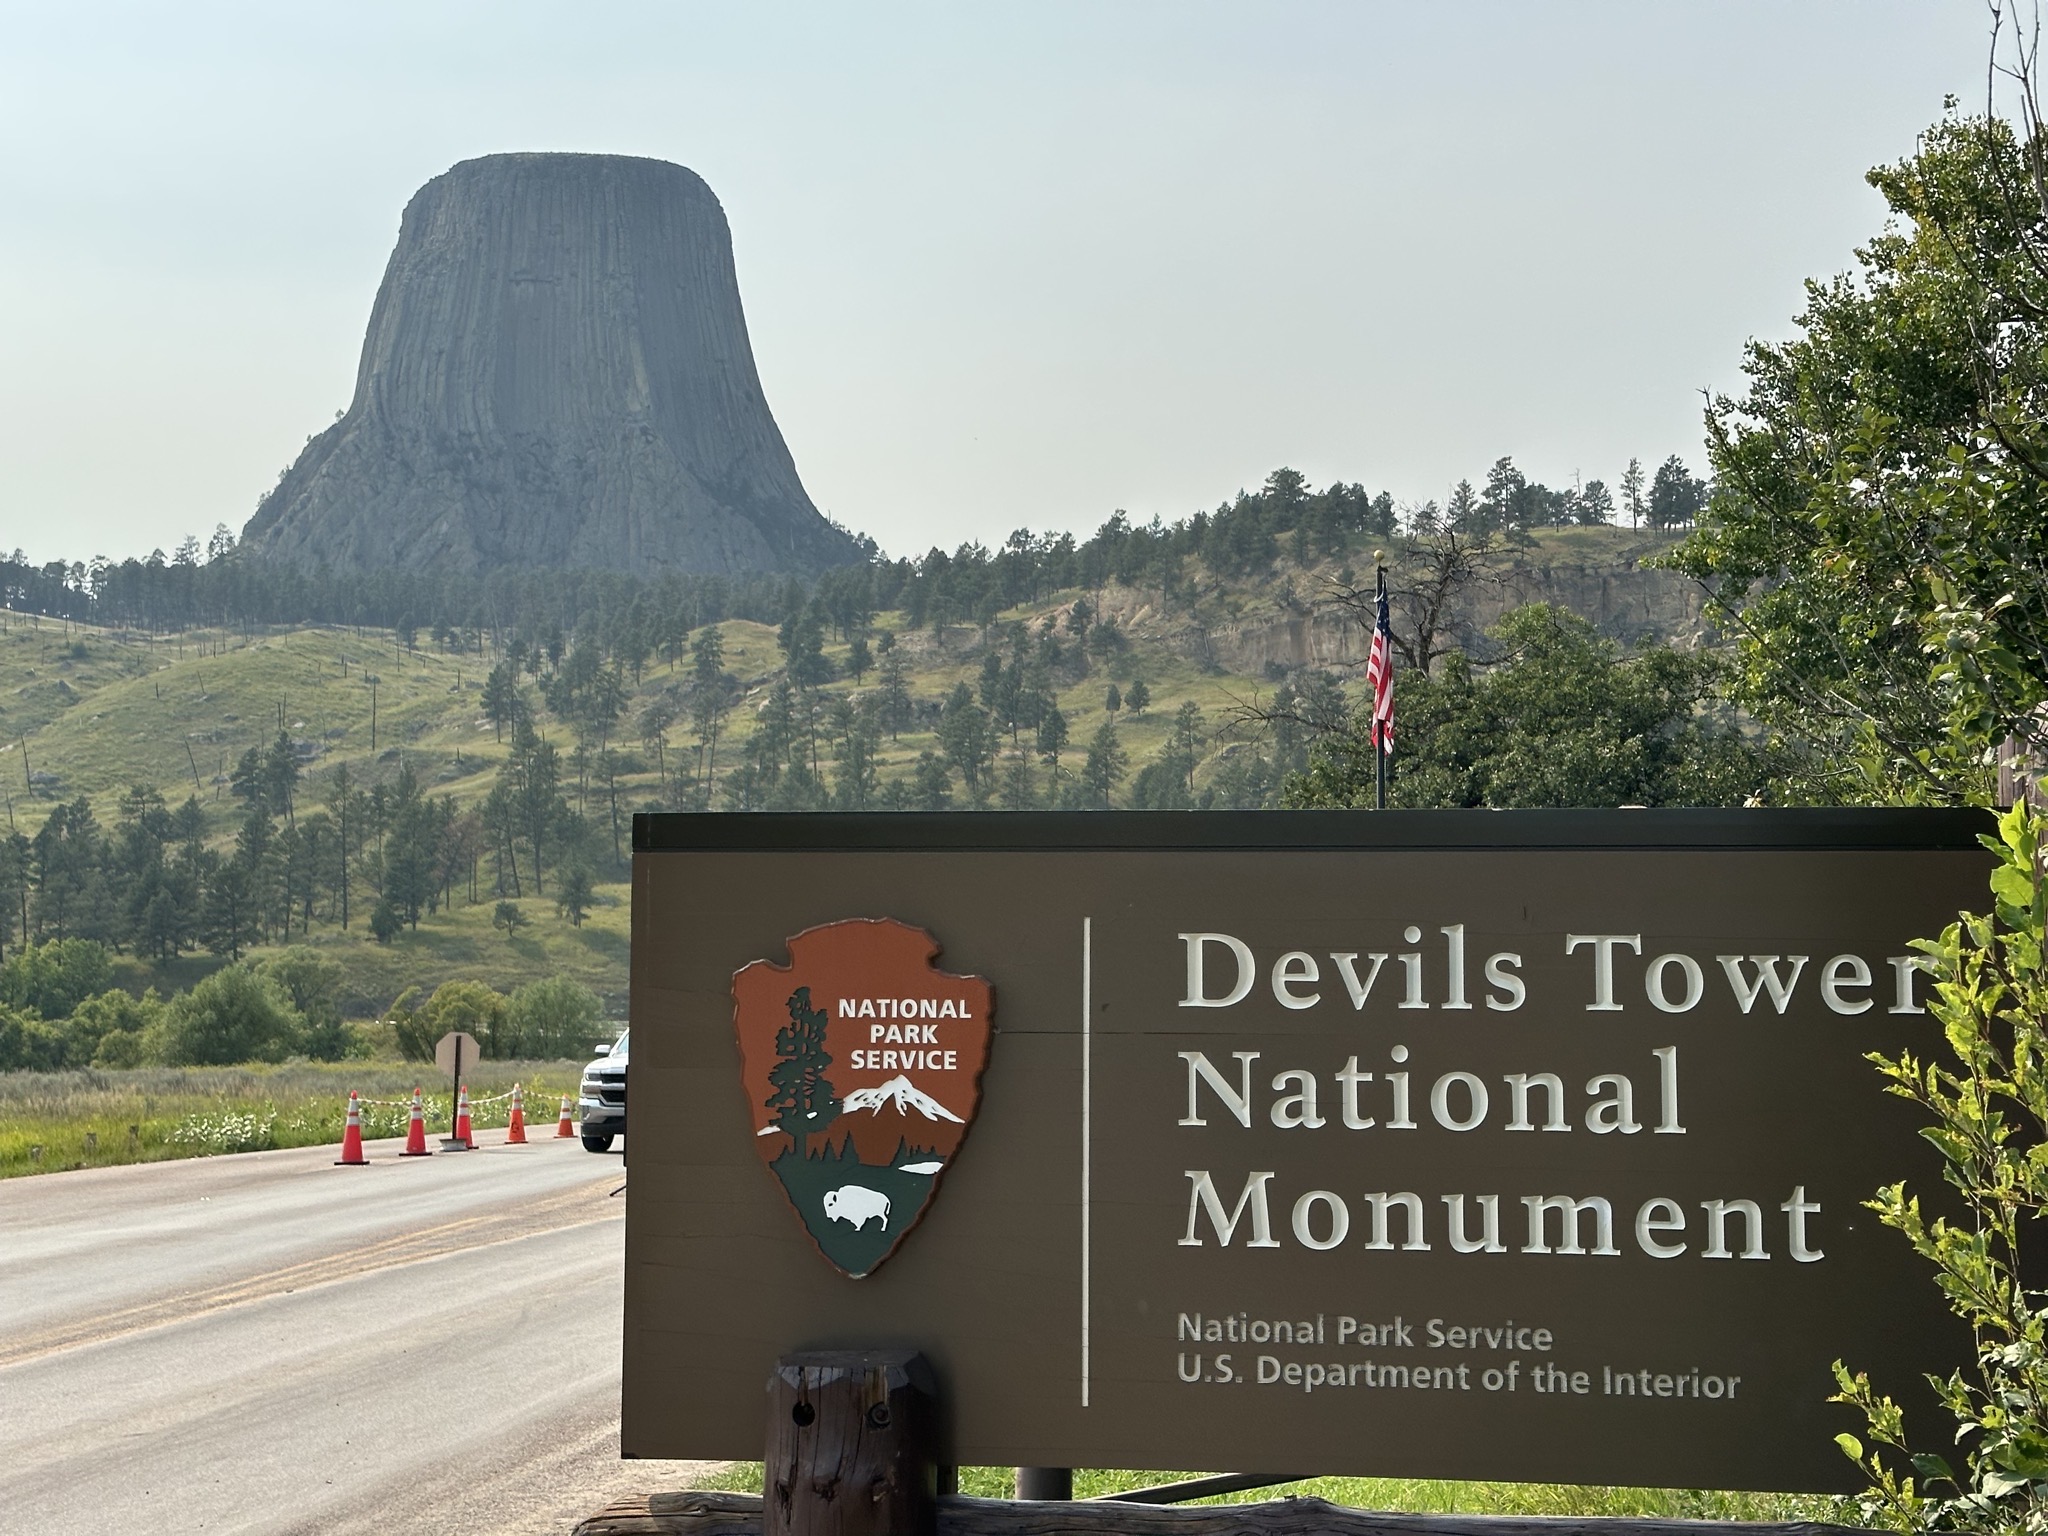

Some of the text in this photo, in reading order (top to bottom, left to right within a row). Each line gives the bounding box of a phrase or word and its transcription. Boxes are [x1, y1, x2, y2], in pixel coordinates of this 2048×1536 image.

[1177, 924, 1940, 1016] Devils Tower
[838, 998, 972, 1019] NATIONAL
[870, 1024, 938, 1044] PARK
[850, 1049, 957, 1070] SERVICE
[1177, 1045, 1687, 1135] National
[1177, 1170, 1825, 1263] Monument
[1177, 1312, 1554, 1352] National Park Service
[1177, 1352, 1742, 1399] U.S. Department of the Interior
